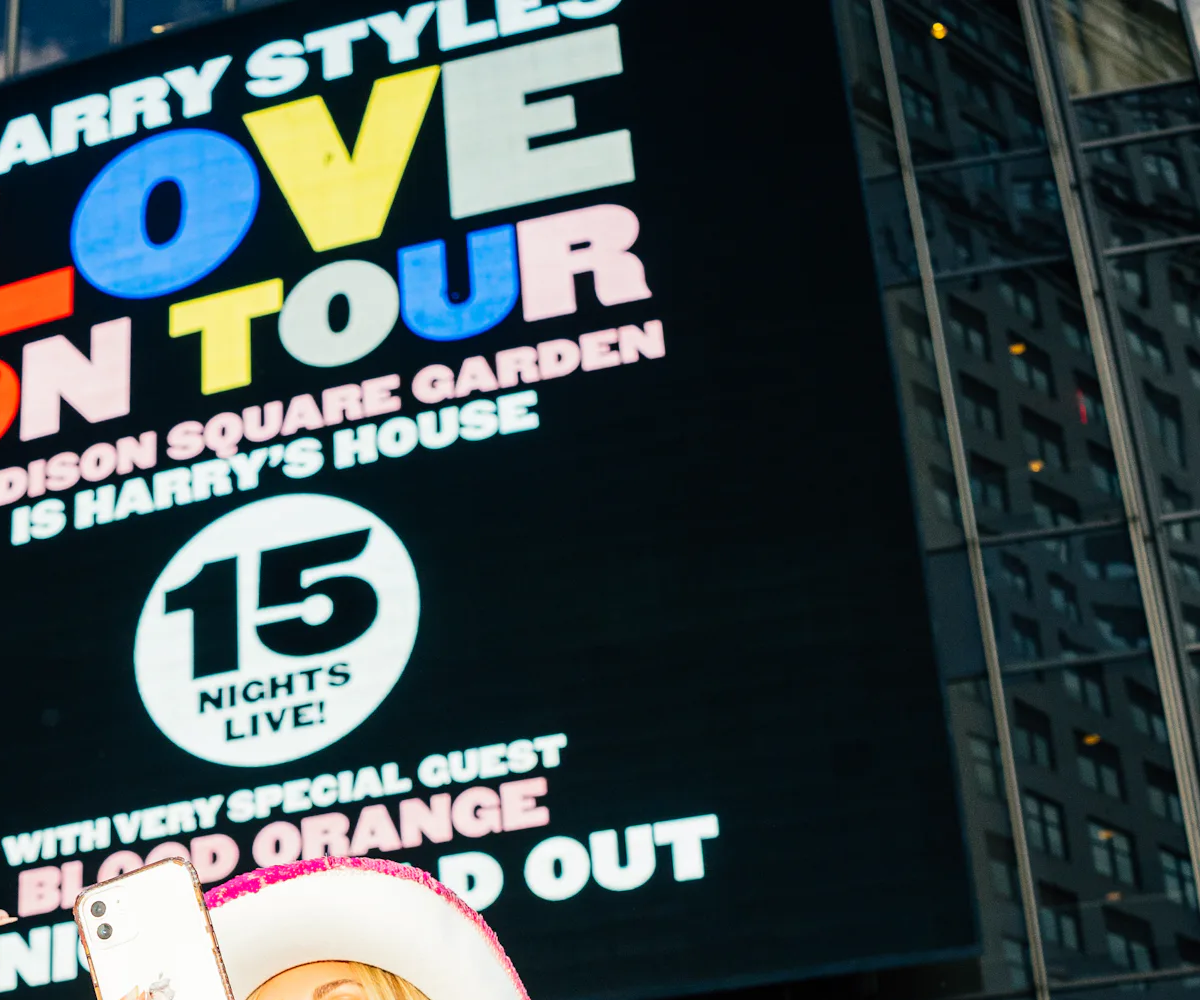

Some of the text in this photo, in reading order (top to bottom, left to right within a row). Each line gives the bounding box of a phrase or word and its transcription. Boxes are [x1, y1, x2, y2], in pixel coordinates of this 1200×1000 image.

[169, 204, 652, 395] TOUR
[166, 373, 402, 460] SQUARE
[411, 319, 666, 404] GARDEN
[10, 390, 540, 546] IS HARRY'S HOUSE
[163, 527, 380, 681] 15
[199, 663, 352, 714] NIGHTS
[224, 701, 327, 742] LIVE!
[2, 733, 568, 867] WITH VERY SPECIAL GUEST
[251, 777, 551, 868] ORANGE
[524, 813, 721, 902] OUT
